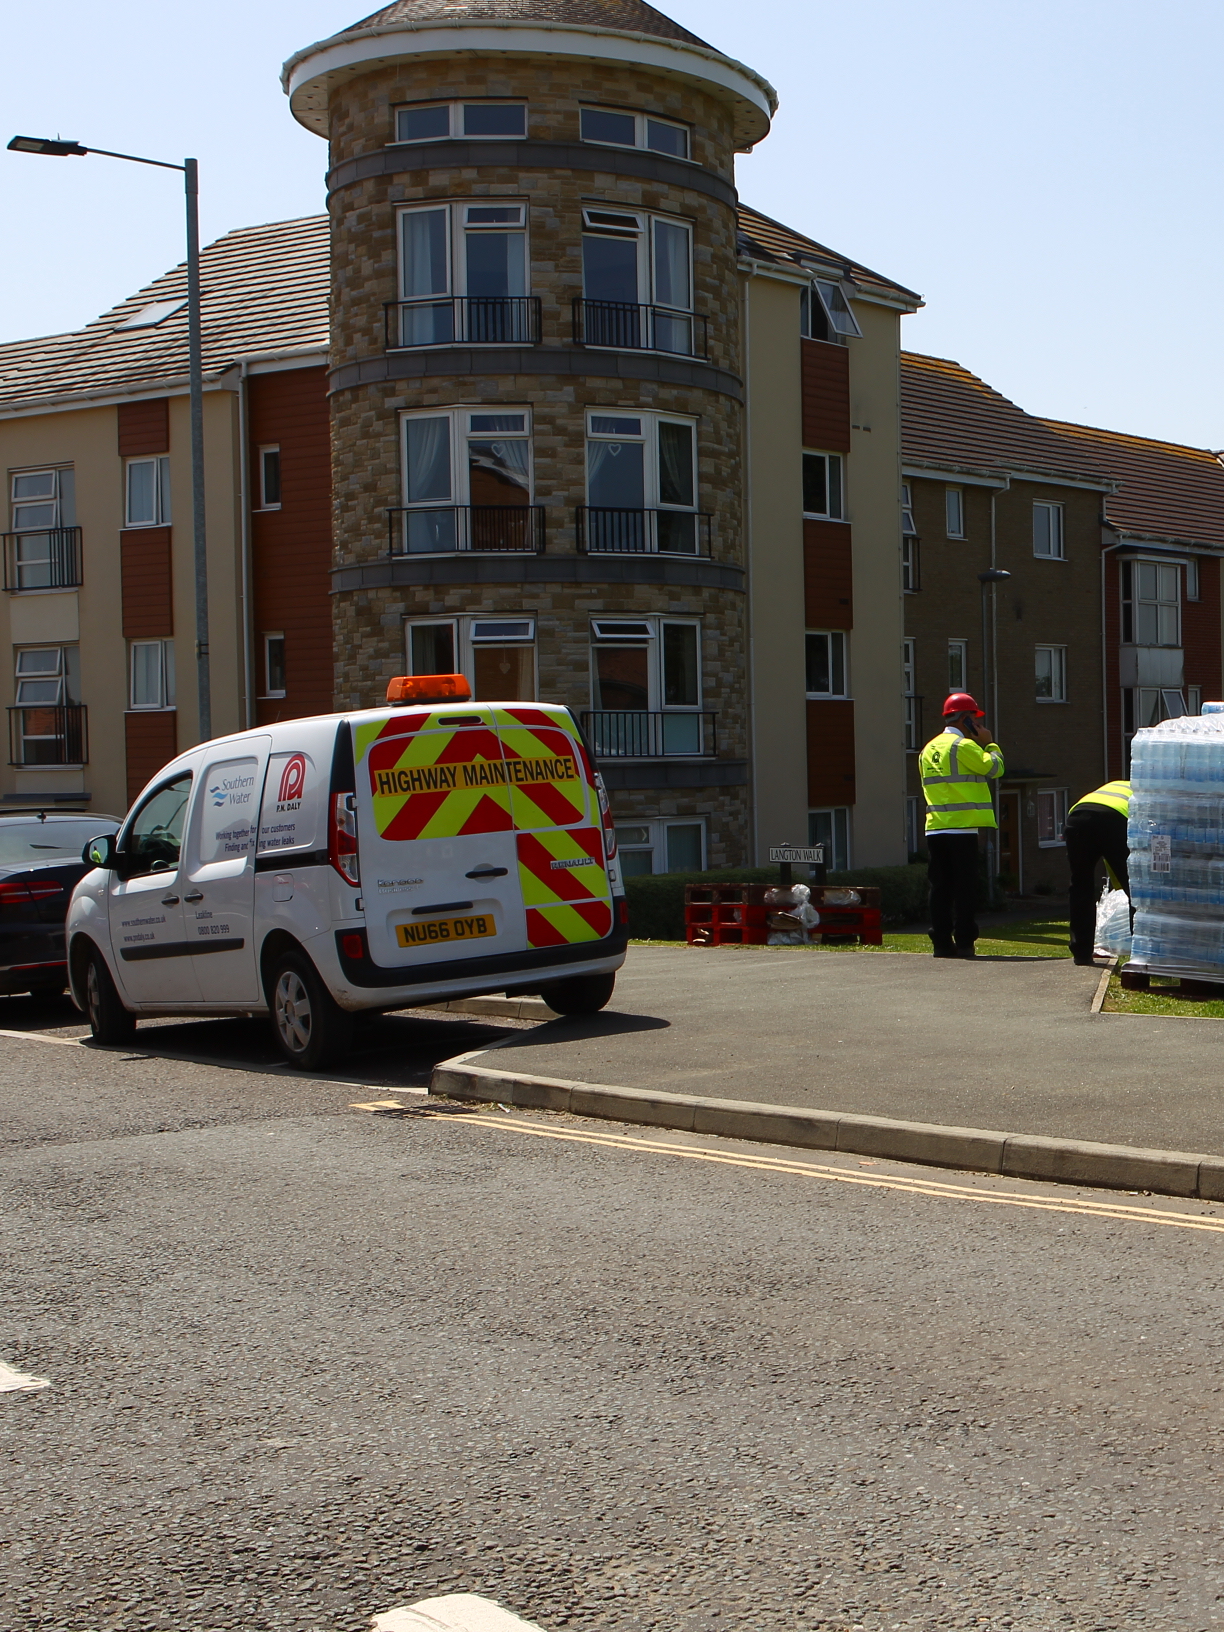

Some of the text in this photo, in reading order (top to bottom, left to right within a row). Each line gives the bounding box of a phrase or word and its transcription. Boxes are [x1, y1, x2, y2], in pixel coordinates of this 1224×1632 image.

[377, 758, 575, 794] HIGHWAY MAINTENANCE
[222, 776, 254, 791] Southern
[229, 793, 251, 805] Water
[286, 802, 302, 811] DALY
[232, 828, 250, 840] together
[261, 826, 270, 834] our
[270, 823, 296, 833] customers
[225, 842, 240, 852] Finding
[267, 838, 281, 847] water
[281, 836, 295, 845] leaks
[771, 849, 821, 862] LANGTON WALK
[551, 857, 596, 869] RENAULT
[197, 926, 210, 935] 0800
[220, 924, 230, 933] 999
[403, 917, 487, 943] NU66 OYB
